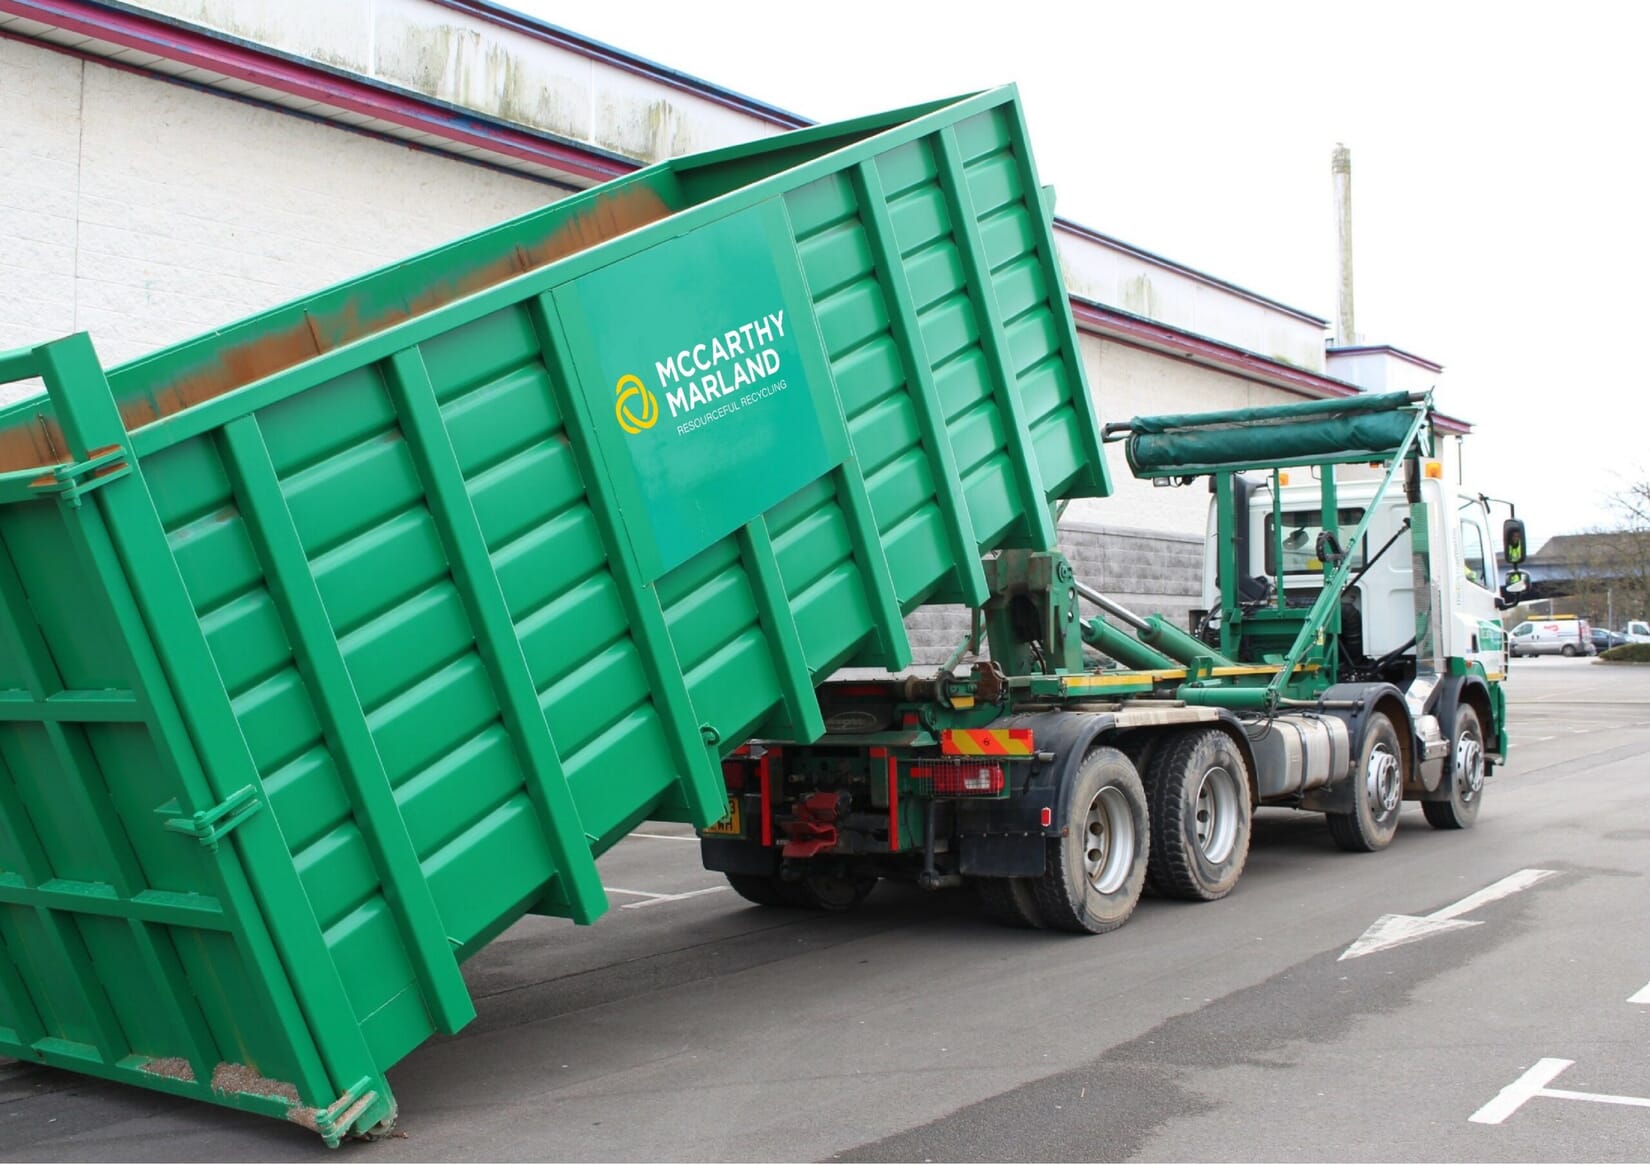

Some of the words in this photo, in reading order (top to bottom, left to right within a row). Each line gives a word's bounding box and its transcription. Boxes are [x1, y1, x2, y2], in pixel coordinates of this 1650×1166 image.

[655, 310, 785, 388] MCCARTHY
[665, 348, 781, 418] MARLAND
[677, 400, 740, 436] RESOURCEFUL
[741, 379, 788, 406] RECYCLING
